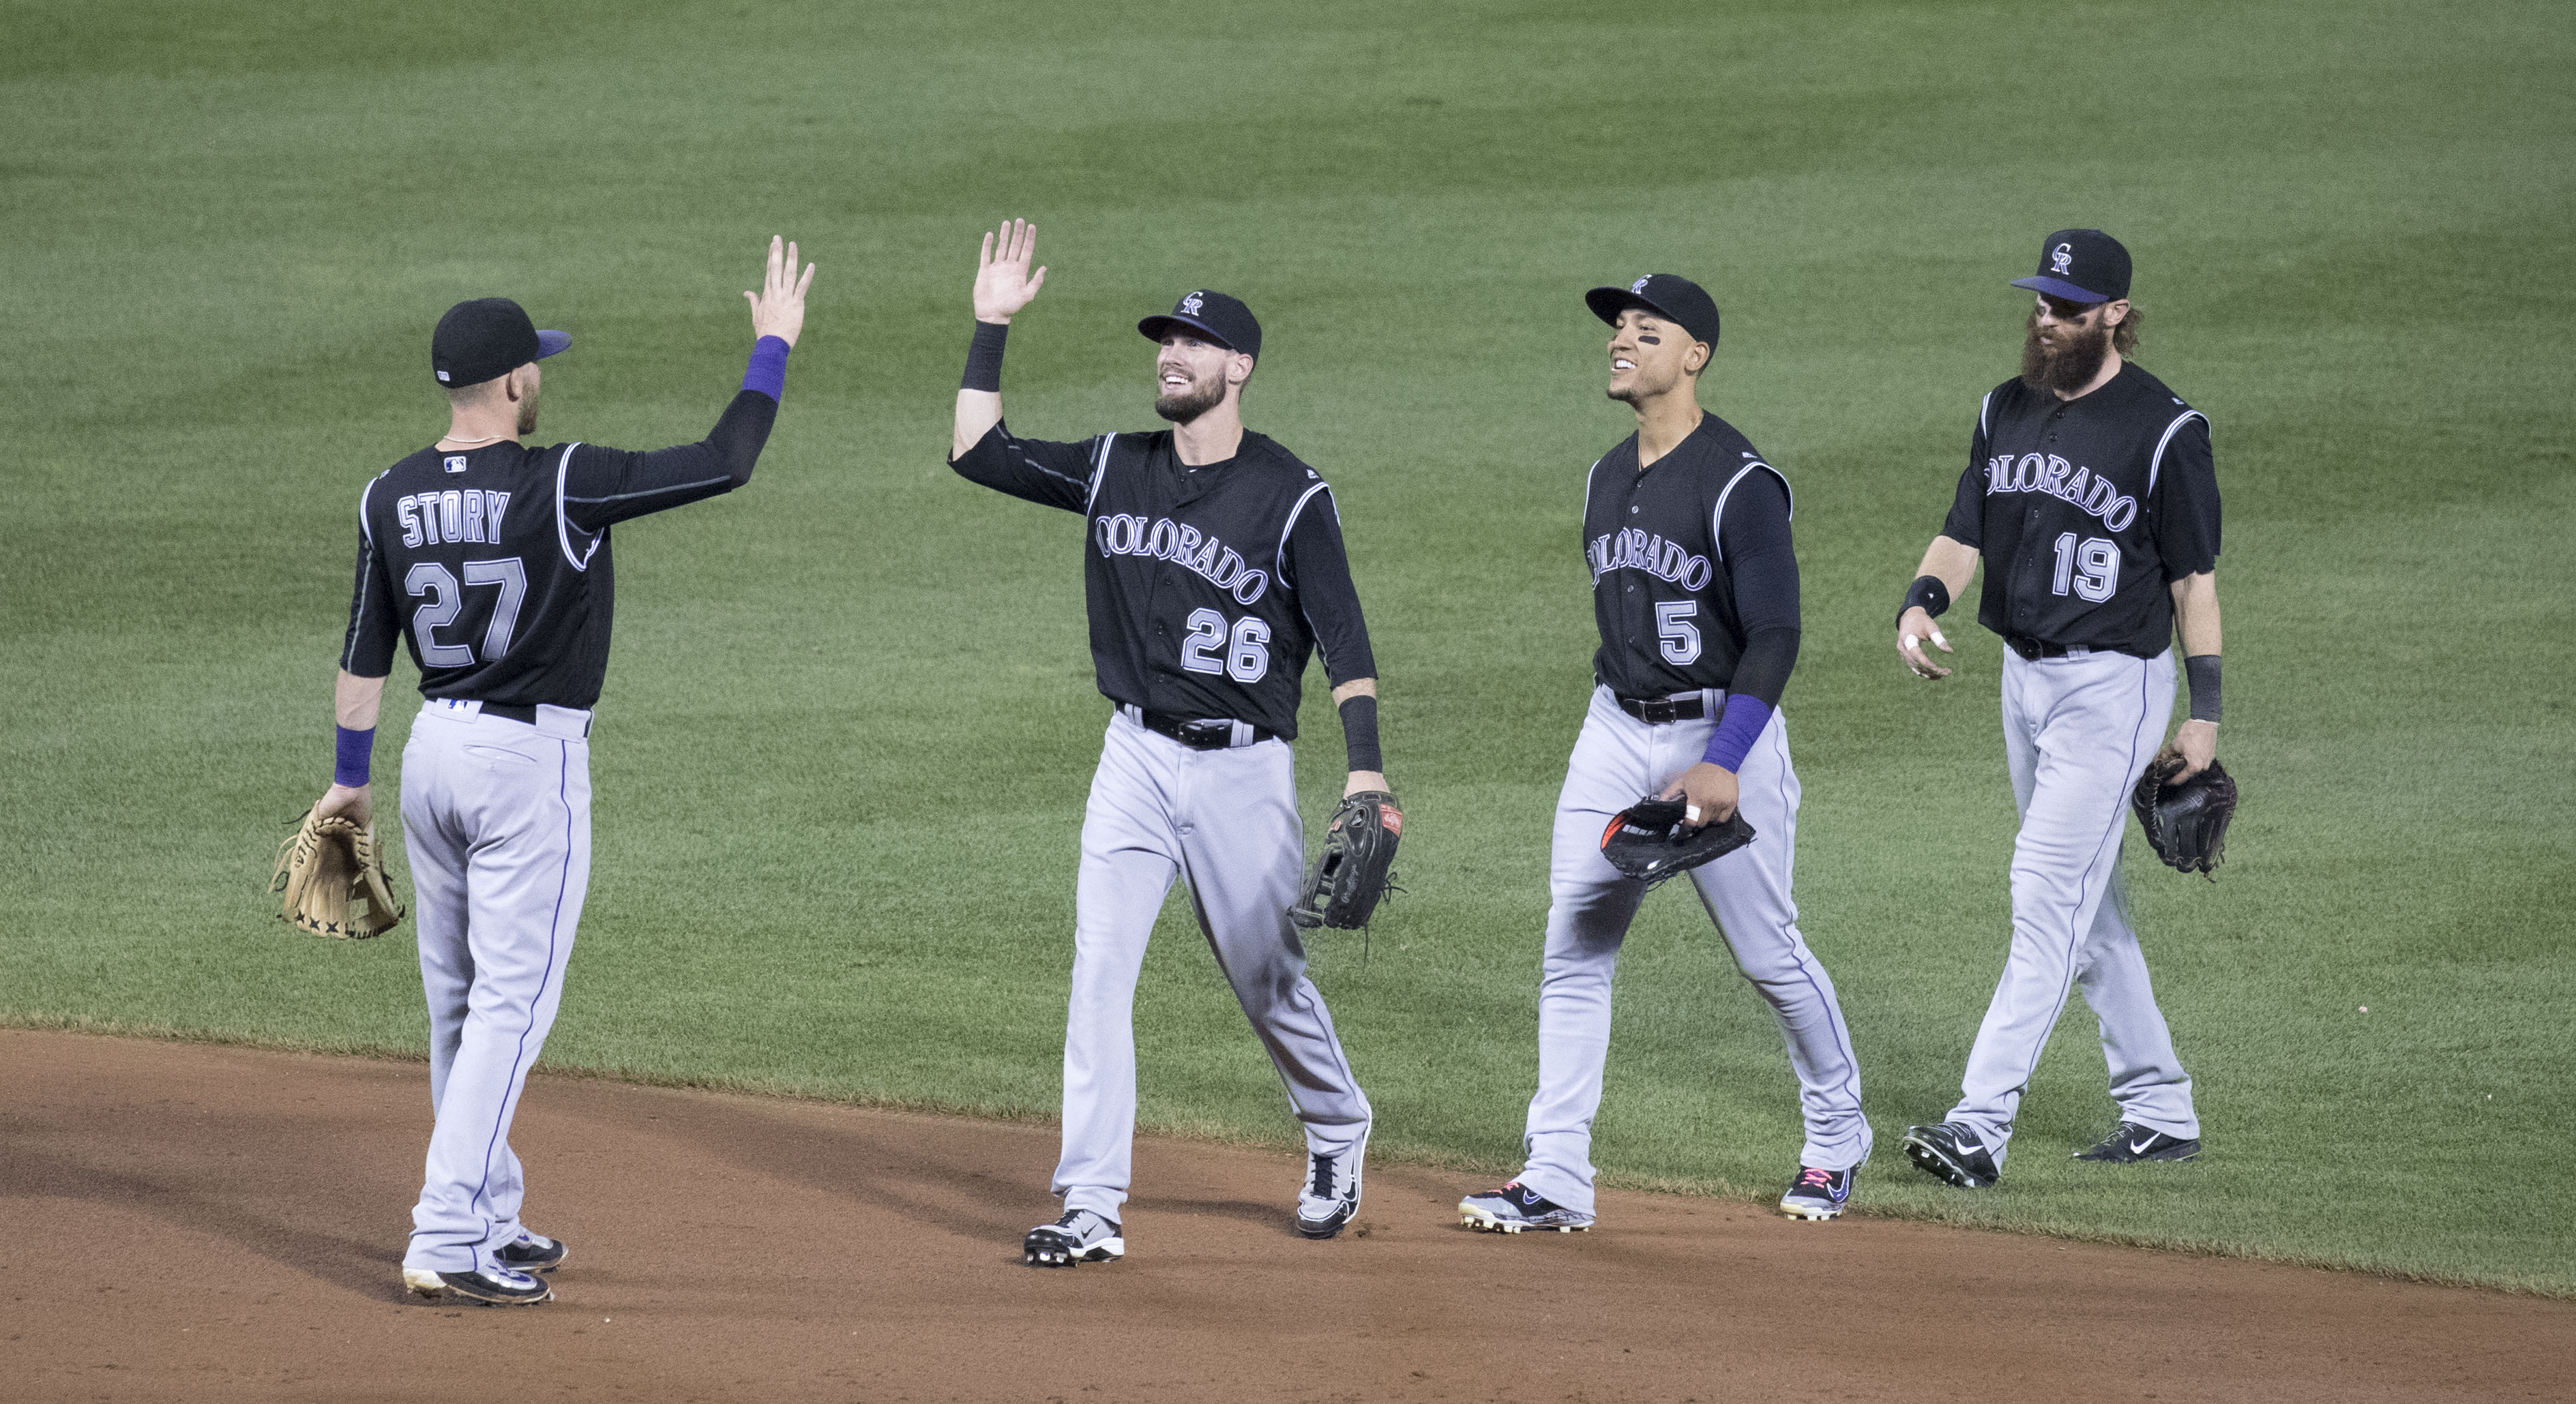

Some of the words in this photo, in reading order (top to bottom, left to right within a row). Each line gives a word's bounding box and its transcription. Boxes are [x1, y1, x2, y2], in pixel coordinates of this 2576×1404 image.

[2051, 243, 2072, 275] CR
[1181, 291, 1204, 316] CR
[397, 490, 512, 548] STORY
[1983, 452, 2137, 532] OLORADO
[1095, 513, 1269, 606] COLORADO
[2052, 532, 2121, 603] 19
[404, 556, 528, 668] 27
[1181, 608, 1271, 683] 26
[1655, 599, 1702, 666] 5
